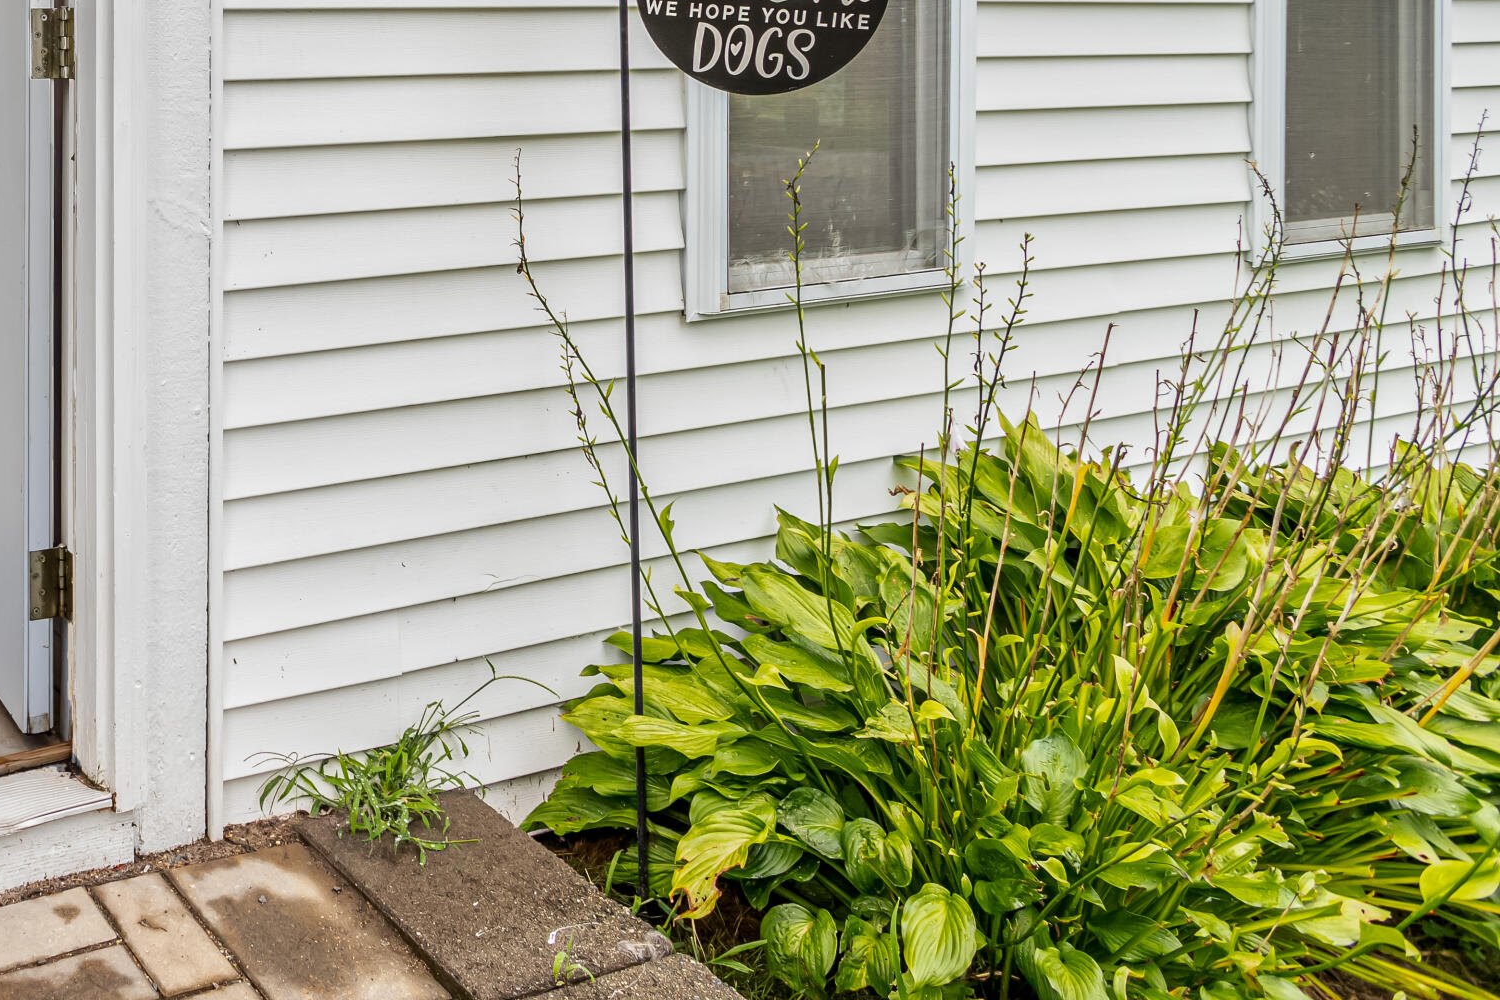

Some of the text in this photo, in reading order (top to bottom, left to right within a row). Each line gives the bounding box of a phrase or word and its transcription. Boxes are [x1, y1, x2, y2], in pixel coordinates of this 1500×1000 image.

[646, 0, 871, 30] WE HOPE YOU LIKE
[692, 22, 816, 80] DOGS
